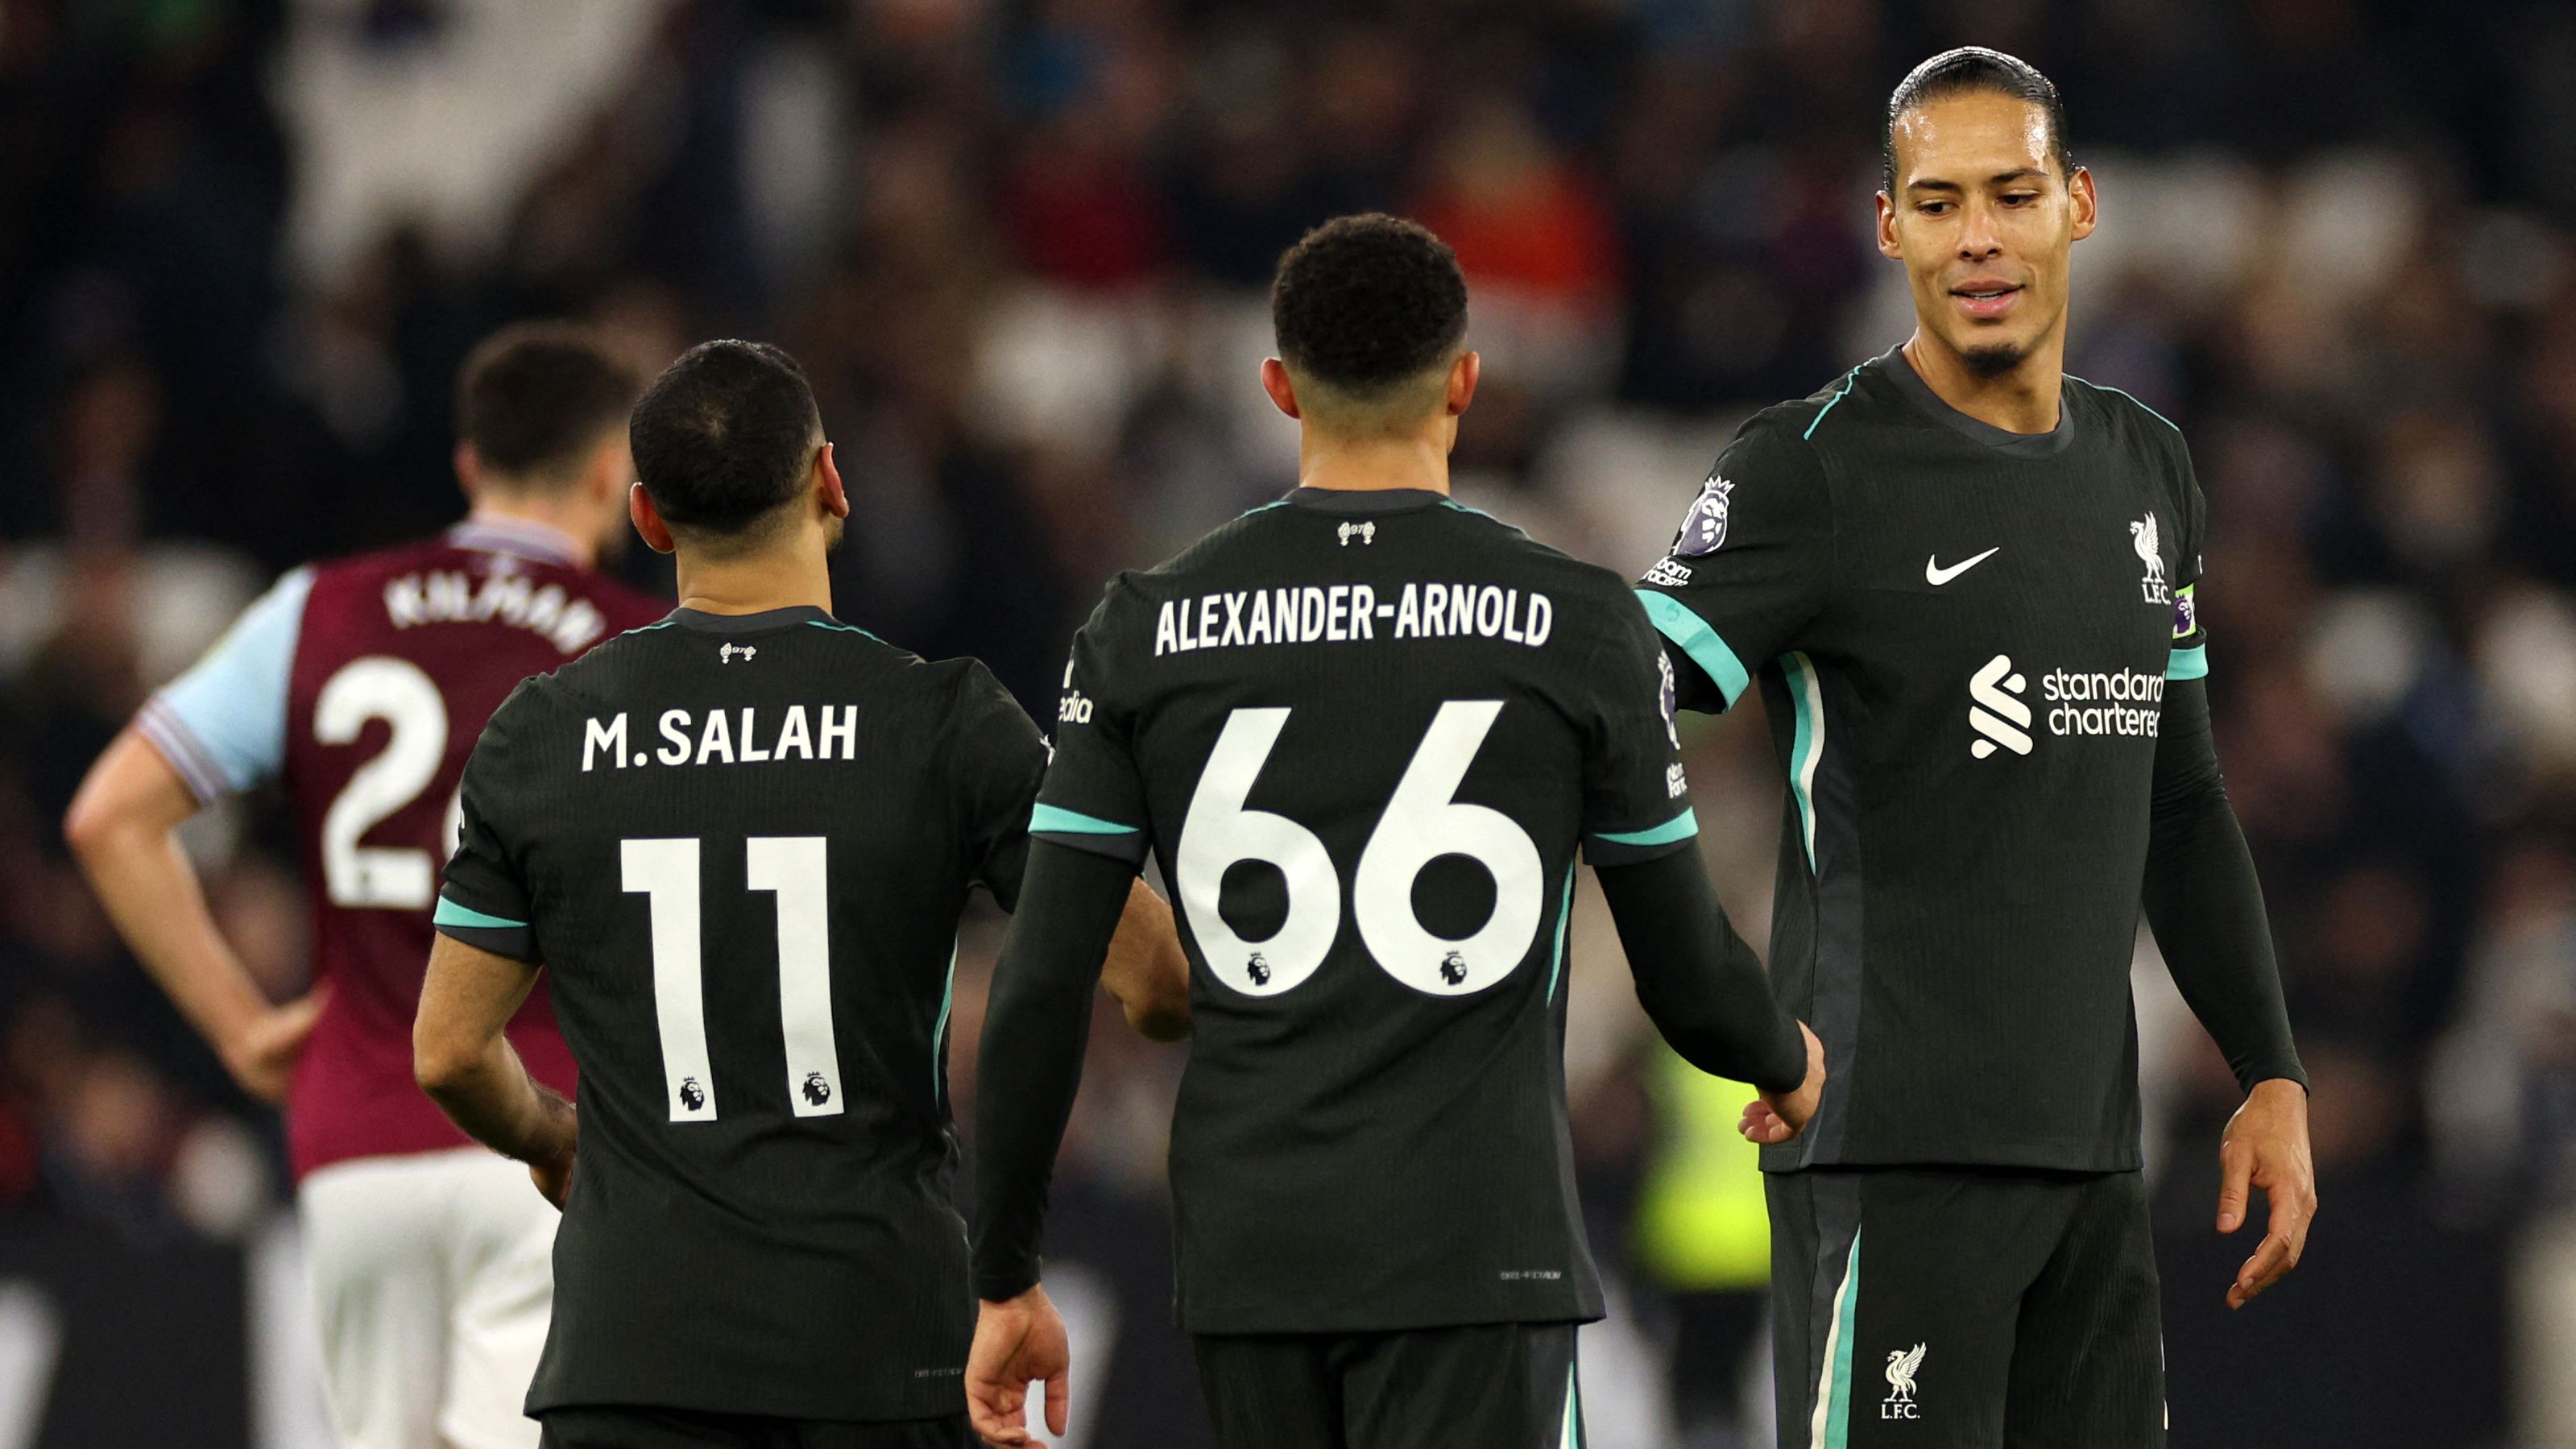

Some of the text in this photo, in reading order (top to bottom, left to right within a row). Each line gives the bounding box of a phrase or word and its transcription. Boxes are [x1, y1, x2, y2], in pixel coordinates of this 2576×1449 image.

[1654, 556, 1692, 580] oom
[384, 570, 607, 654] KILMAN
[1155, 583, 1552, 656] ALEXANDER-ARNOLD
[1058, 689, 1094, 724] edia
[2042, 666, 2166, 703] standard
[582, 704, 858, 772] M.SALAH
[314, 656, 463, 909] 2
[1175, 699, 1545, 997] 66
[619, 835, 844, 1122] 11
[1881, 1403, 1921, 1419] L.F.C.
